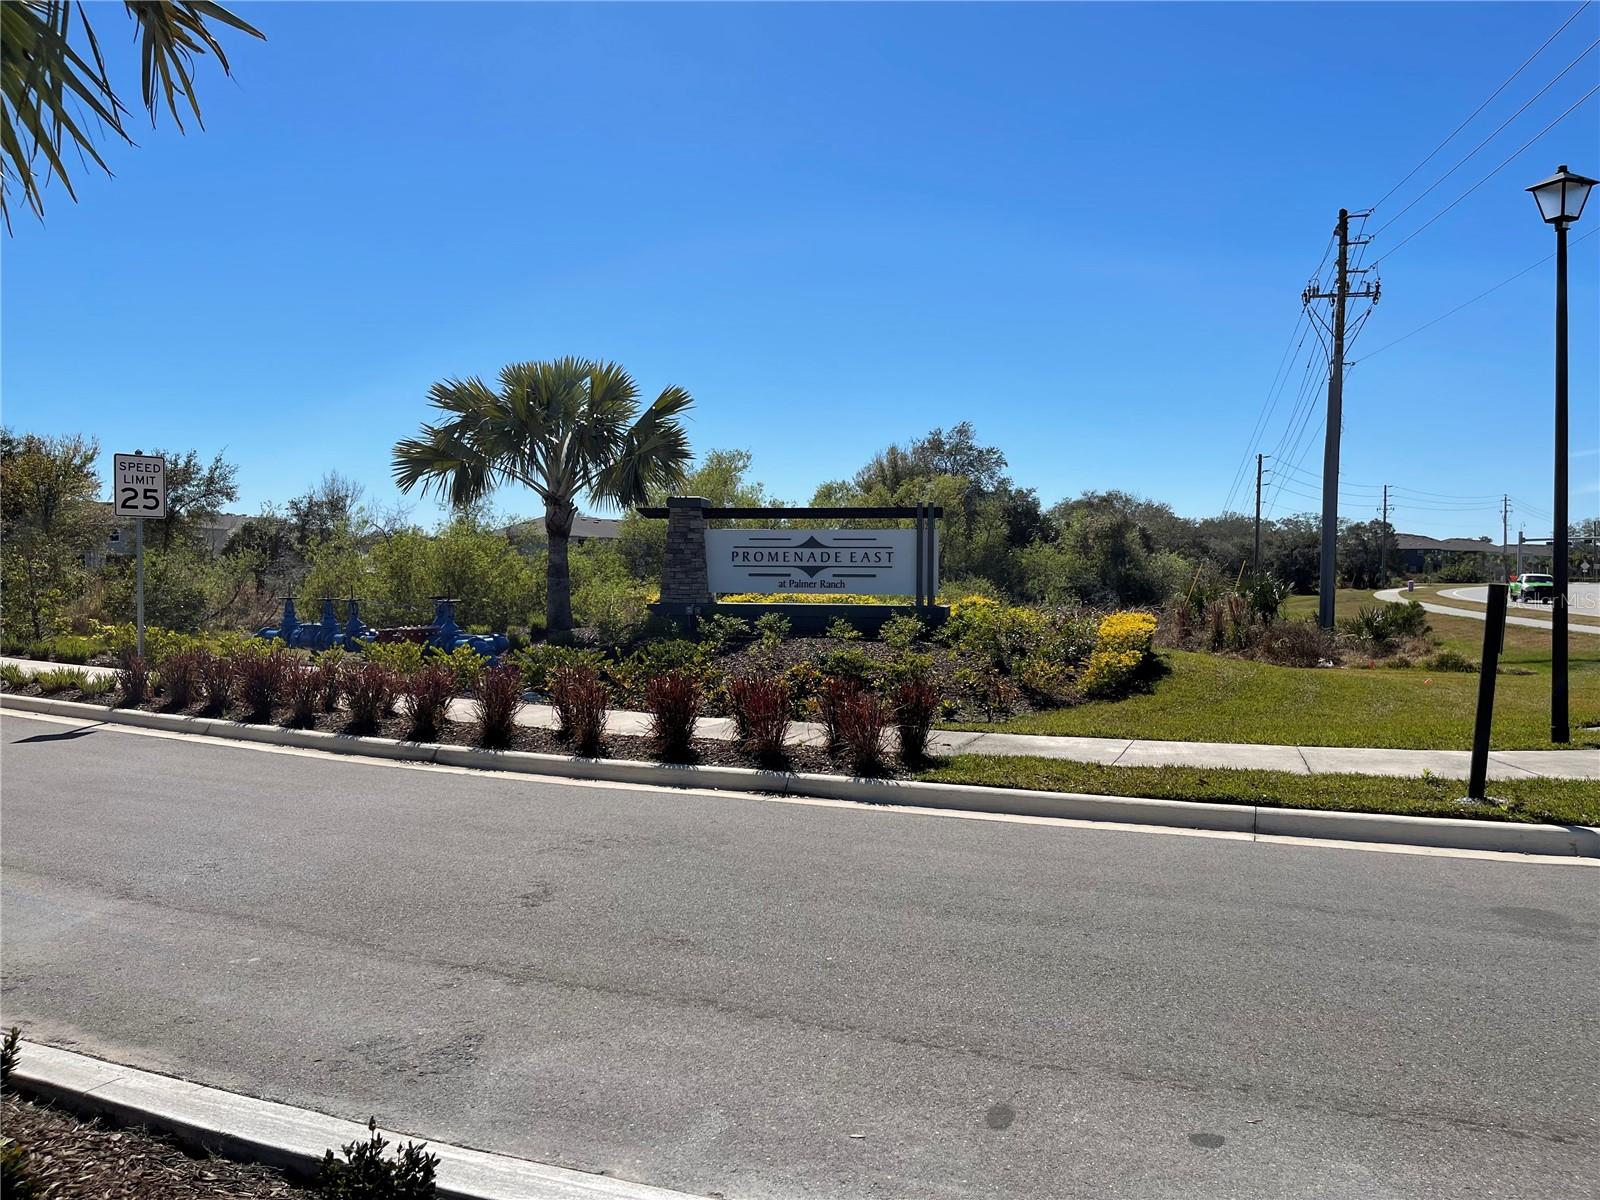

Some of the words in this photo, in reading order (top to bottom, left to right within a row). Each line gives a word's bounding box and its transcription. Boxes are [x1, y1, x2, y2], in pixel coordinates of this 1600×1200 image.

[119, 462, 161, 473] SPEED
[123, 474, 156, 485] LIMIT
[120, 487, 160, 510] 25
[731, 551, 842, 563] PROMENADE
[850, 551, 894, 563] EAST
[778, 580, 786, 588] at
[788, 580, 817, 589] Palmer
[819, 580, 846, 589] Ranch
